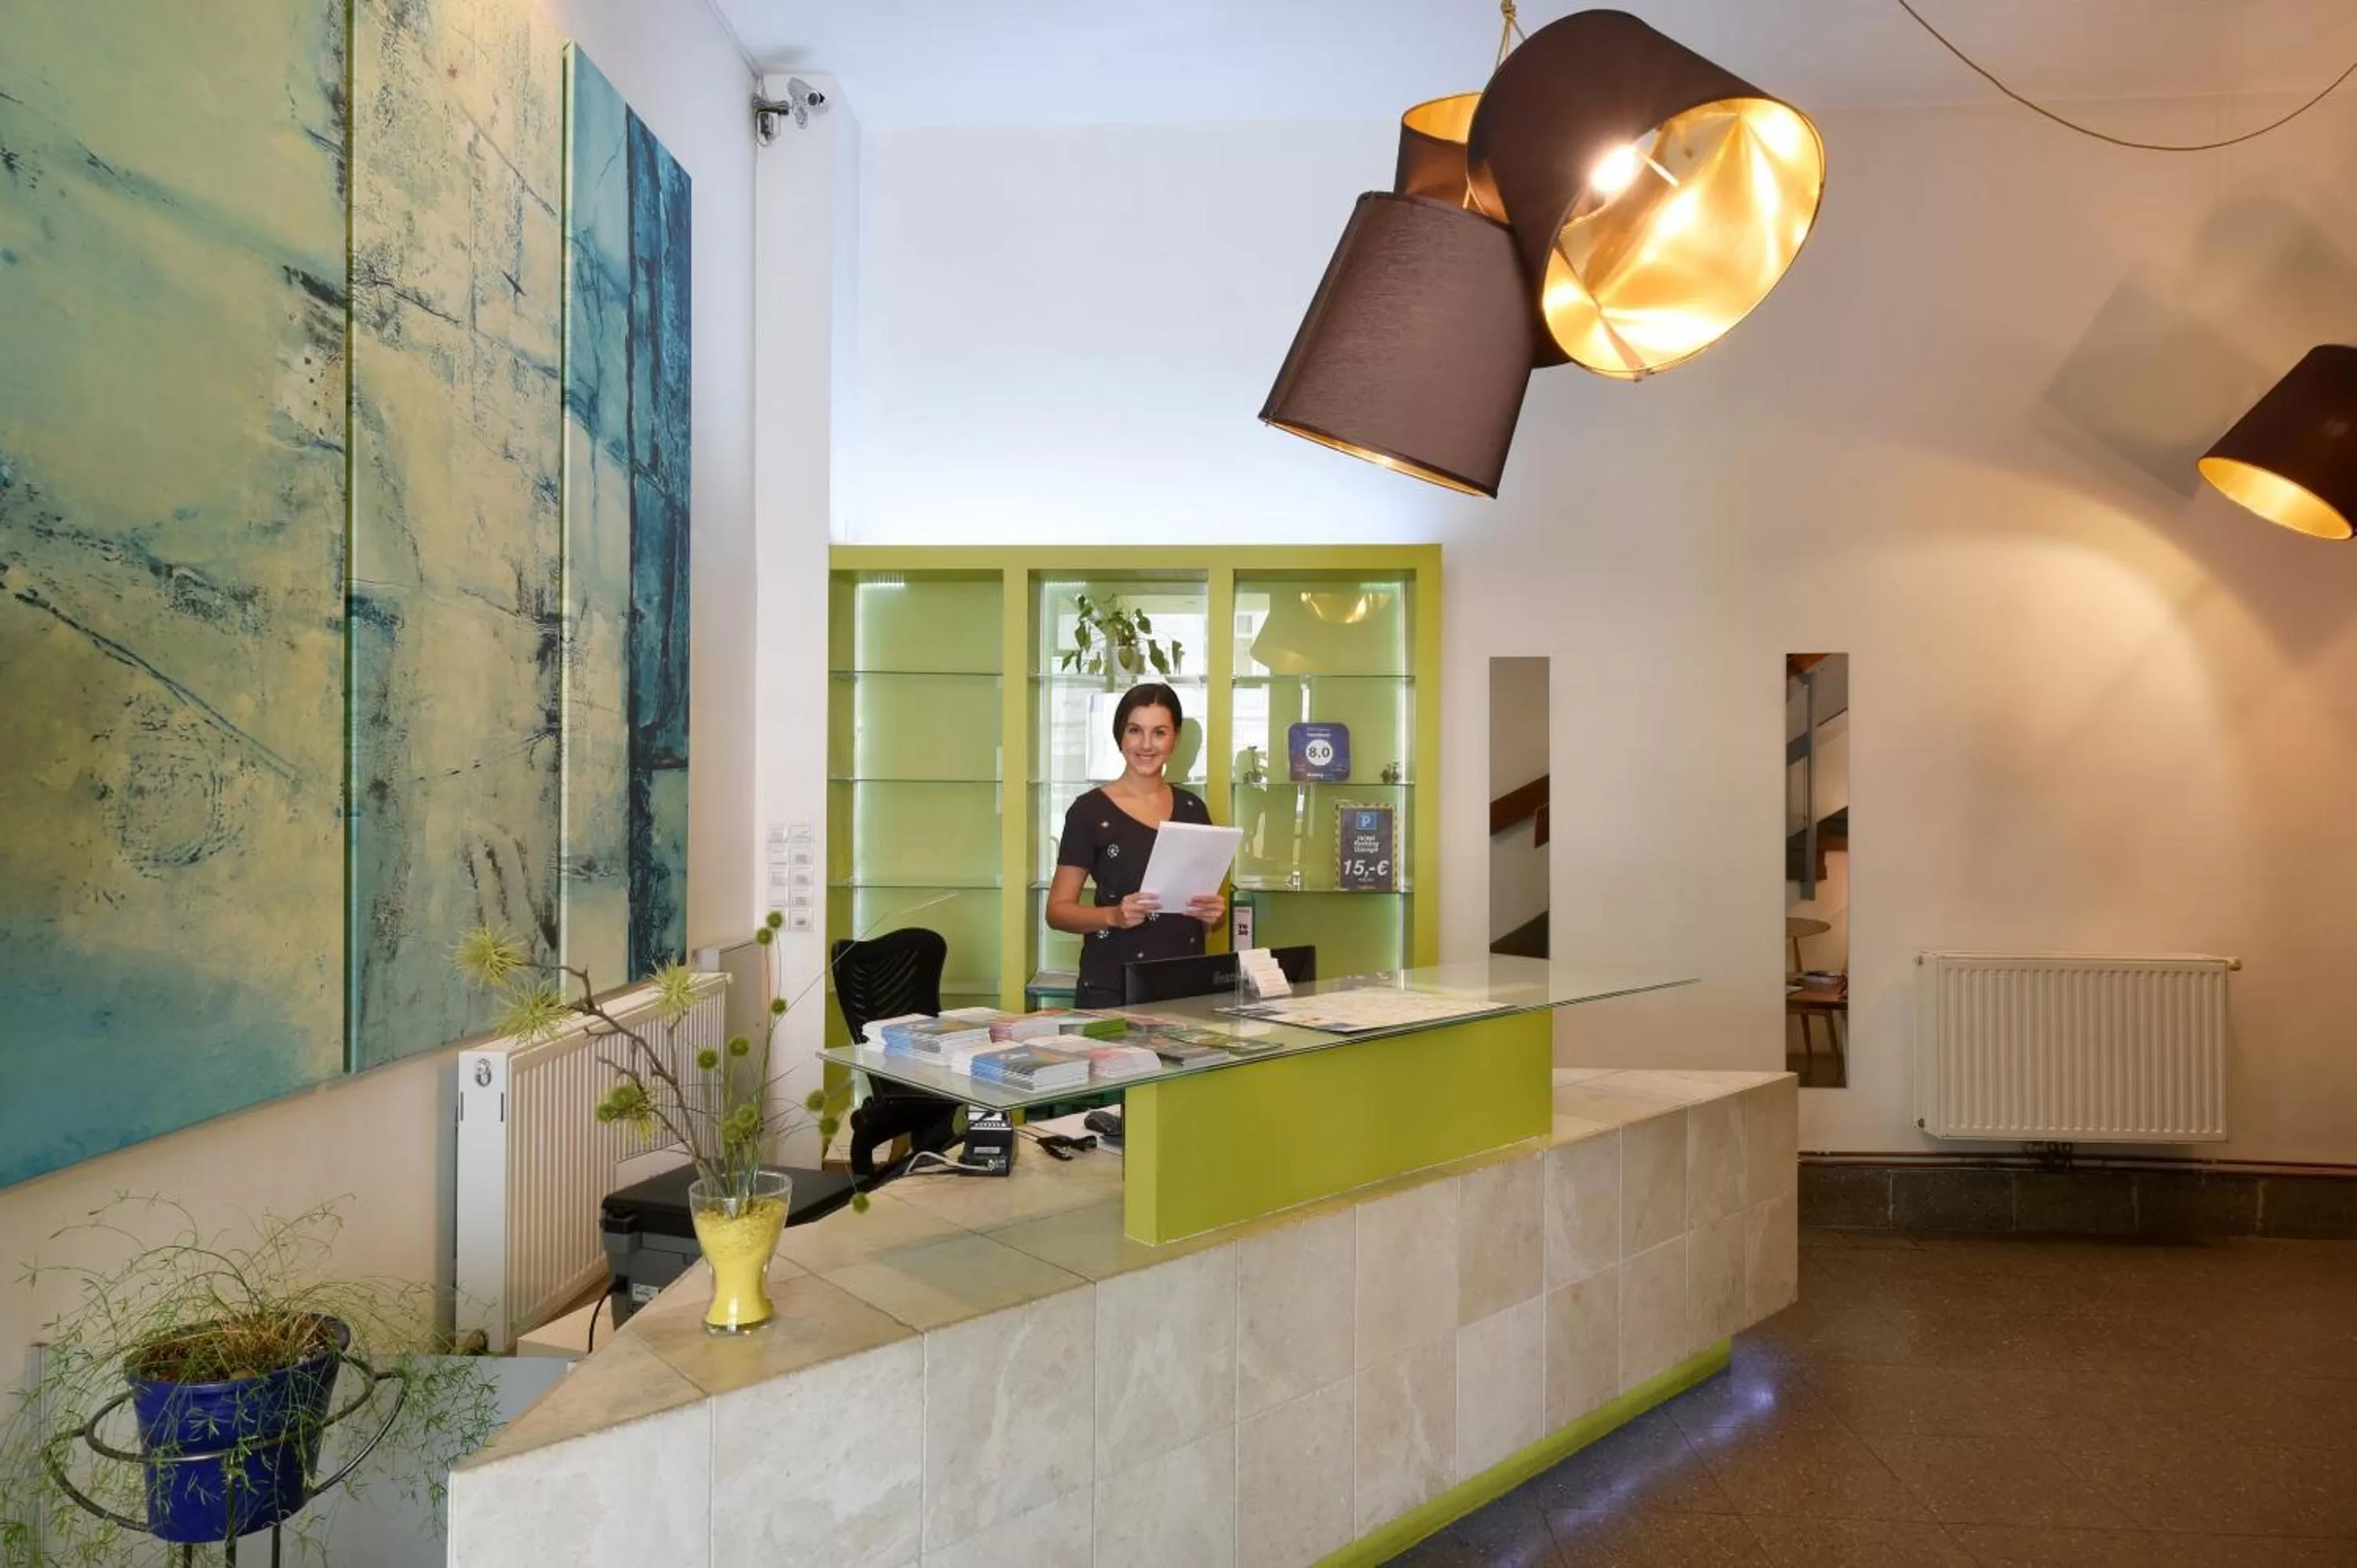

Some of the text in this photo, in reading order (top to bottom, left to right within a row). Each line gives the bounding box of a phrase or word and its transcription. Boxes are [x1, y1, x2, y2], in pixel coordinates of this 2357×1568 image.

[1308, 746, 1331, 759] 8.0
[1361, 814, 1372, 828] P
[1344, 858, 1389, 878] 15,-€
